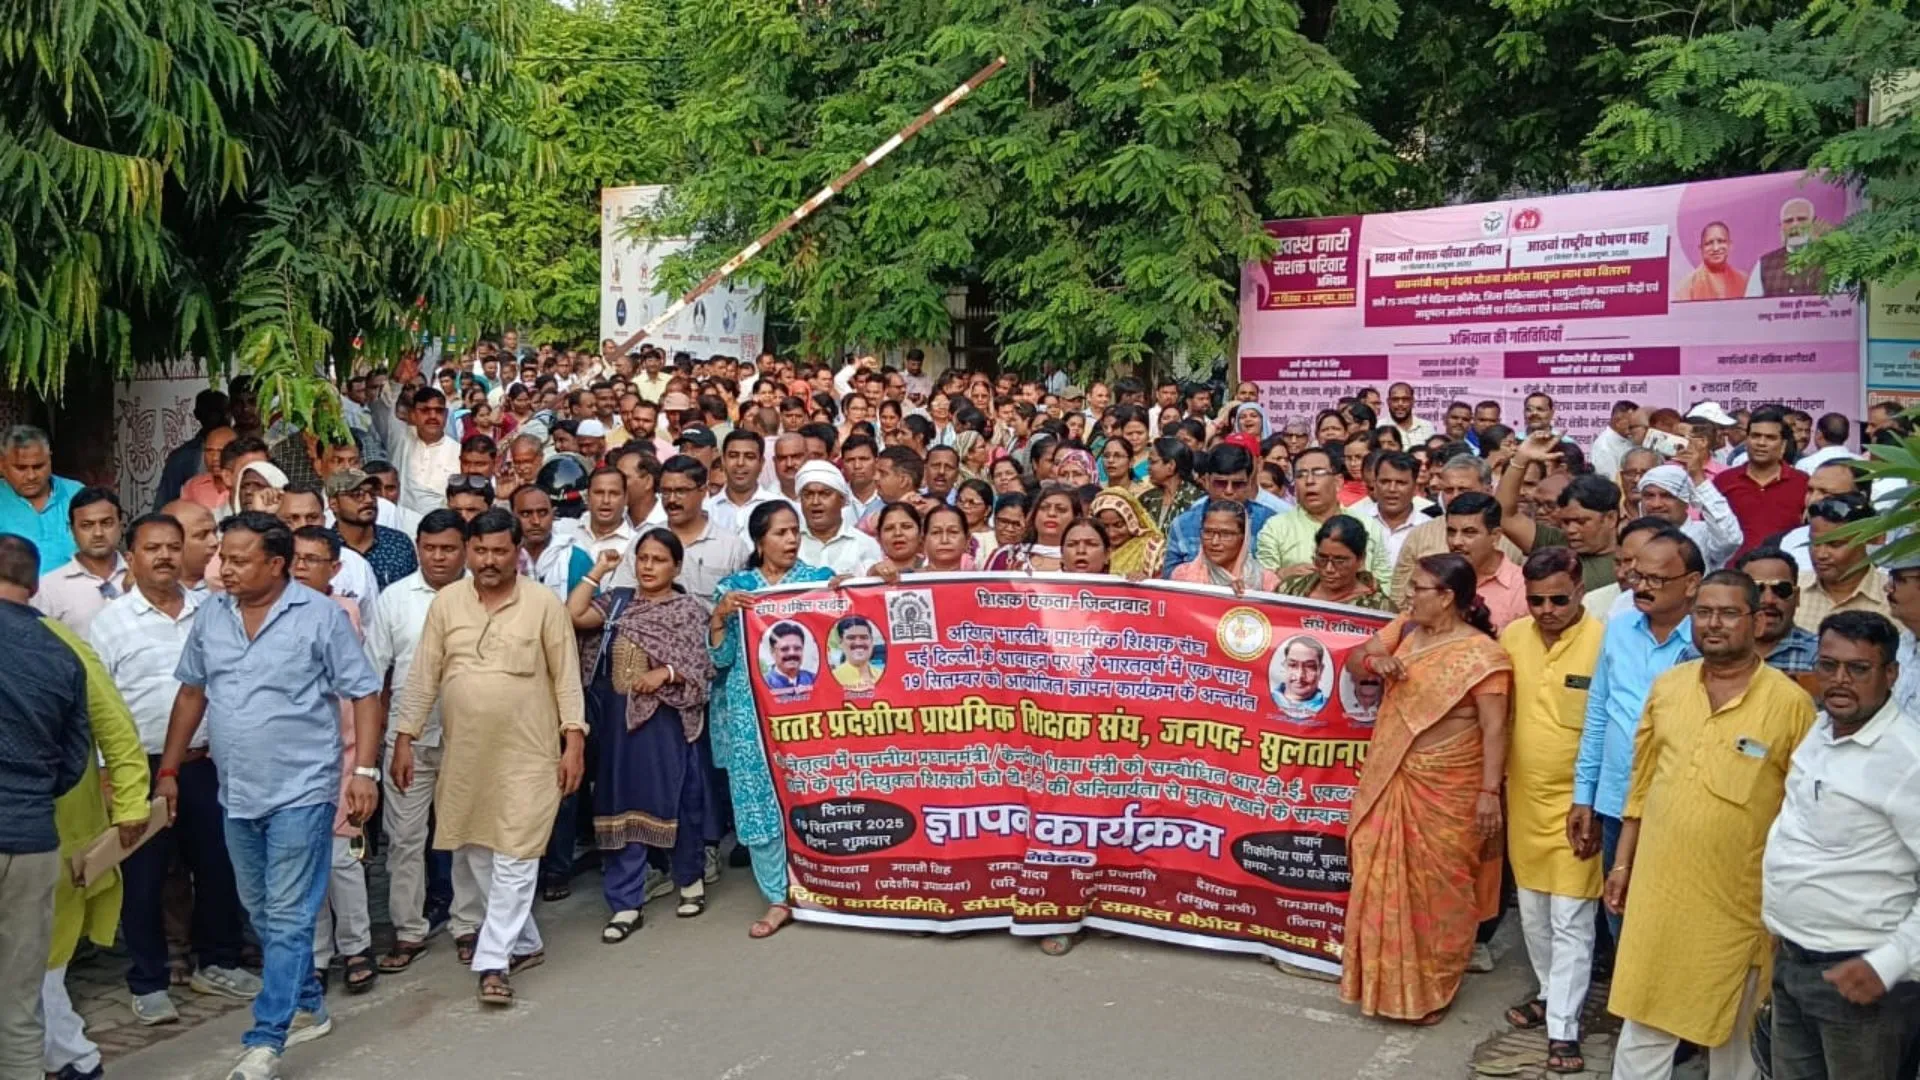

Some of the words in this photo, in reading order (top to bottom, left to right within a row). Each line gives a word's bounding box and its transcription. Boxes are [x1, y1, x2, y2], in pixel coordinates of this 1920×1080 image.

[1317, 228, 1352, 252] नारी
[1308, 254, 1348, 274] परिवार
[1450, 328, 1493, 345] अभियान
[1494, 327, 1508, 344] की
[976, 588, 1023, 608] शिक्षक
[947, 621, 995, 642] अखिल
[997, 622, 1049, 645] भारतीय
[1054, 625, 1120, 648] प्राथमिक
[1122, 627, 1176, 650] शिक्षक
[1178, 635, 1208, 656] संघ
[906, 645, 930, 669] नई
[981, 643, 996, 664] के
[997, 650, 1049, 670] आवाहन
[1051, 654, 1072, 671] पर
[1075, 650, 1099, 677] पूरे
[1100, 654, 1166, 677] भारतवर्ष
[1169, 655, 1184, 678] में
[1187, 662, 1213, 682] एक
[1214, 665, 1251, 687] साथ
[903, 674, 922, 692] 19
[924, 667, 982, 692] सितम्बर
[983, 667, 1002, 688] को
[1004, 669, 1065, 695] आयोजित
[1067, 678, 1112, 697] ज्ञापन
[1115, 676, 1177, 699] कार्यक्रम
[1179, 680, 1197, 702] के
[1199, 688, 1258, 712] अन्तर्गत
[826, 701, 916, 738] प्रदेशीय
[920, 694, 1015, 735] प्राथमिक
[1022, 697, 1093, 741] शिक्षक
[1098, 705, 1150, 748] संघ,
[834, 748, 850, 769] में
[917, 743, 990, 767] प्रधानमंत्री
[1086, 752, 1119, 775] मंत्री
[1121, 753, 1146, 775] को
[1151, 757, 1229, 785] सम्बोधित
[810, 774, 830, 793] के
[832, 770, 857, 796] पूर्व
[858, 771, 917, 795] नियुक्त
[919, 766, 976, 789] शिक्षकों
[978, 766, 1002, 788] को
[1048, 775, 1072, 796] की
[1073, 777, 1161, 799] अनिवार्यता
[1163, 779, 1183, 800] से
[1185, 785, 1226, 807] मुक्त
[1226, 791, 1270, 819] रखने
[1270, 798, 1290, 822] के
[820, 802, 866, 818] दिनांक
[808, 817, 863, 835] सितम्बर
[865, 817, 905, 831] 2025
[1033, 803, 1226, 858] कार्यक्रम
[841, 834, 892, 851] शुक्रवार
[1278, 866, 1305, 878] 2.30
[789, 884, 838, 907] जिला
[1100, 899, 1174, 923] समस्त
[1178, 912, 1243, 934] क्षेत्रीय
